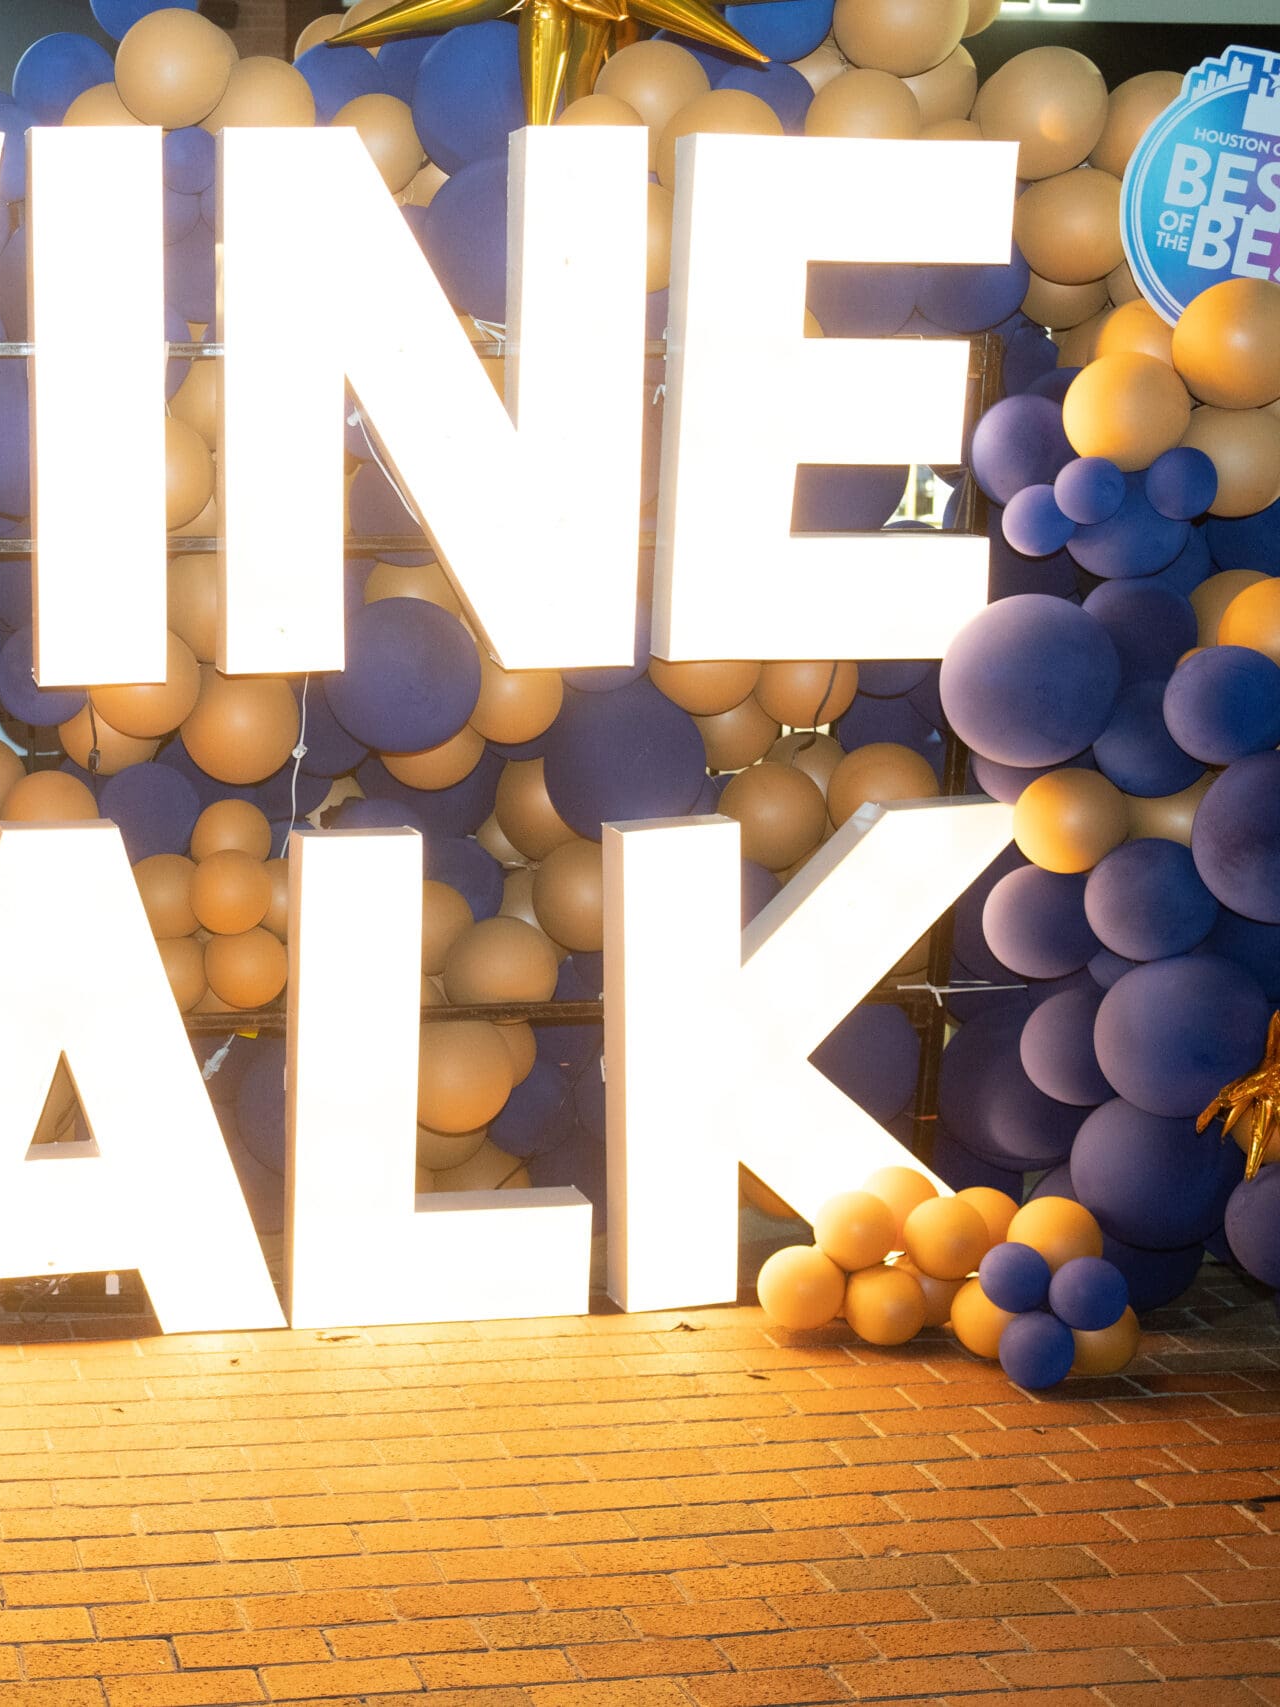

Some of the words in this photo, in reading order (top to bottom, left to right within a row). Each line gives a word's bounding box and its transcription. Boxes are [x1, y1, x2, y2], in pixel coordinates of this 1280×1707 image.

[1193, 127, 1271, 154] HOUSTON
[1158, 209, 1195, 234] OF
[1155, 231, 1190, 252] THE
[1187, 204, 1280, 282] BE
